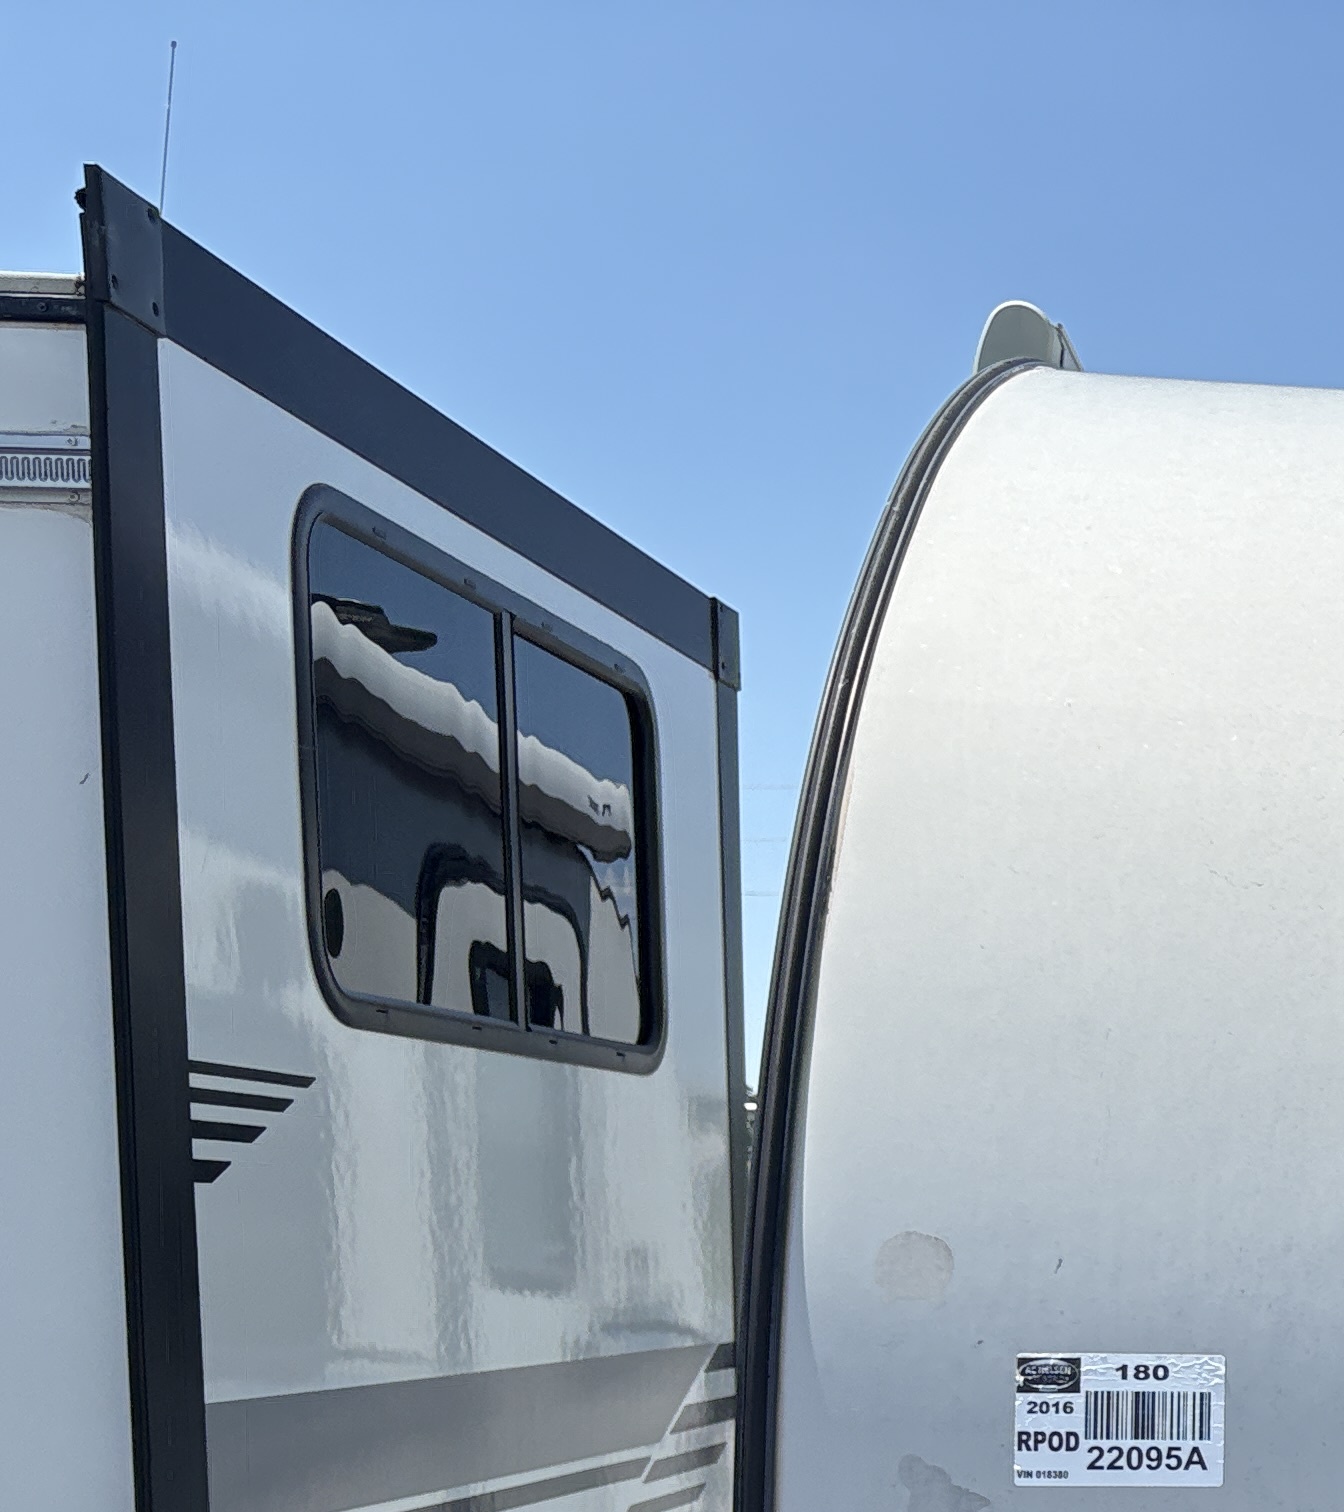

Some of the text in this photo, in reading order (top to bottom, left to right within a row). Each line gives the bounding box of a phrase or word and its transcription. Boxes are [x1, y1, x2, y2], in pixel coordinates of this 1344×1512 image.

[1115, 1364, 1169, 1381] 180
[1027, 1401, 1075, 1415] 2016
[1017, 1431, 1080, 1451] RPOD
[1086, 1446, 1208, 1471] 22095A
[1017, 1470, 1033, 1479] VIN
